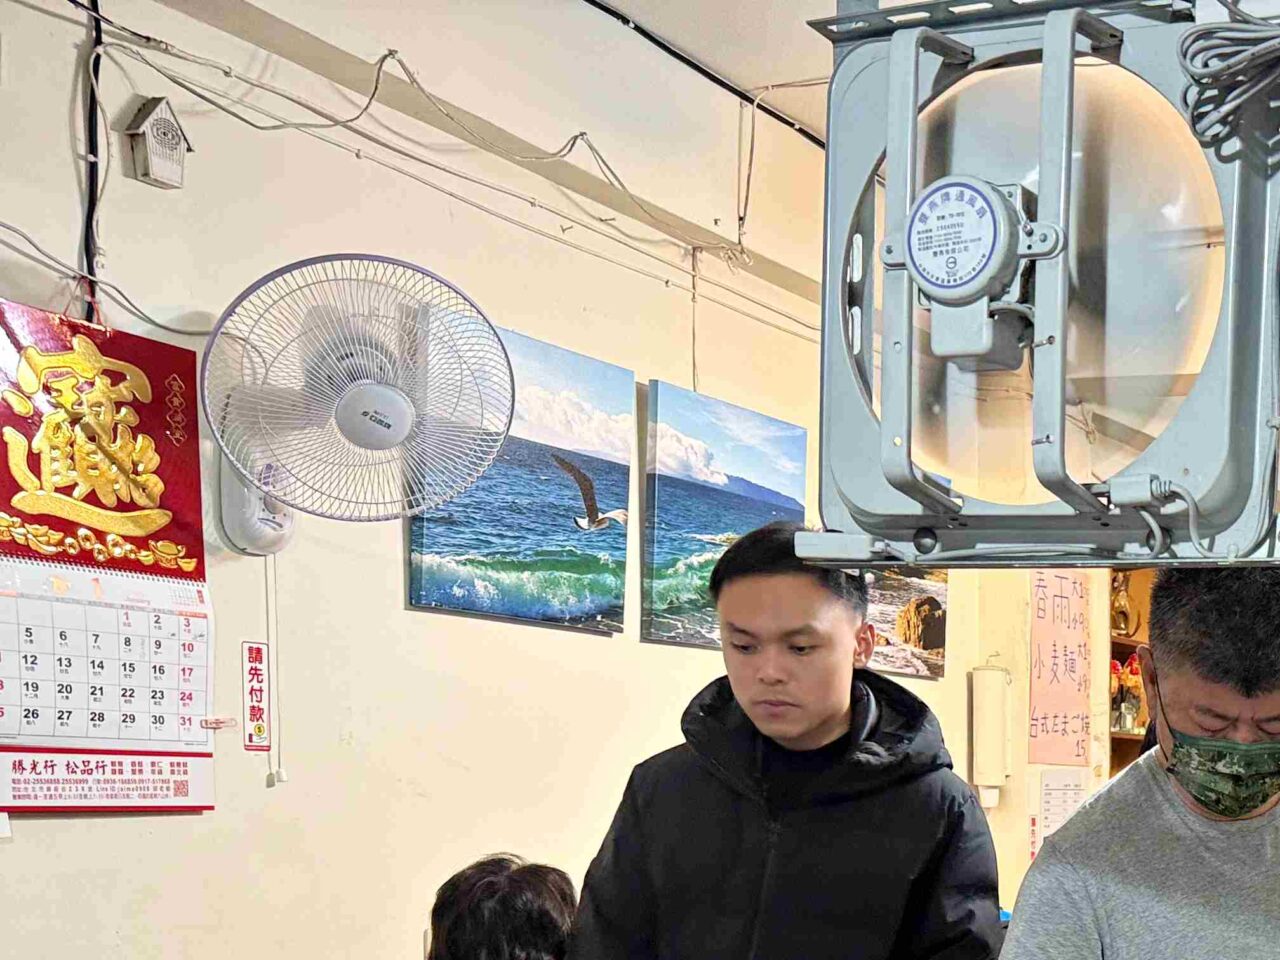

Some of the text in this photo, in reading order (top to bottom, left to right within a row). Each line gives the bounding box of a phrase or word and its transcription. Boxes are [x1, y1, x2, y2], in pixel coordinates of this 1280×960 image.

[154, 615, 160, 624] 2
[184, 618, 190, 627] 3
[26, 628, 193, 652] 5 6 7 8 9 10
[22, 655, 193, 676] 12 13 14 15 16 17
[24, 682, 192, 701] 19 20 21 22 23 24
[248, 646, 264, 723] 請先付款
[24, 709, 191, 726] 26 27 28 29 30 31
[12, 759, 57, 775] 勝光行
[66, 760, 108, 776] 松品行
